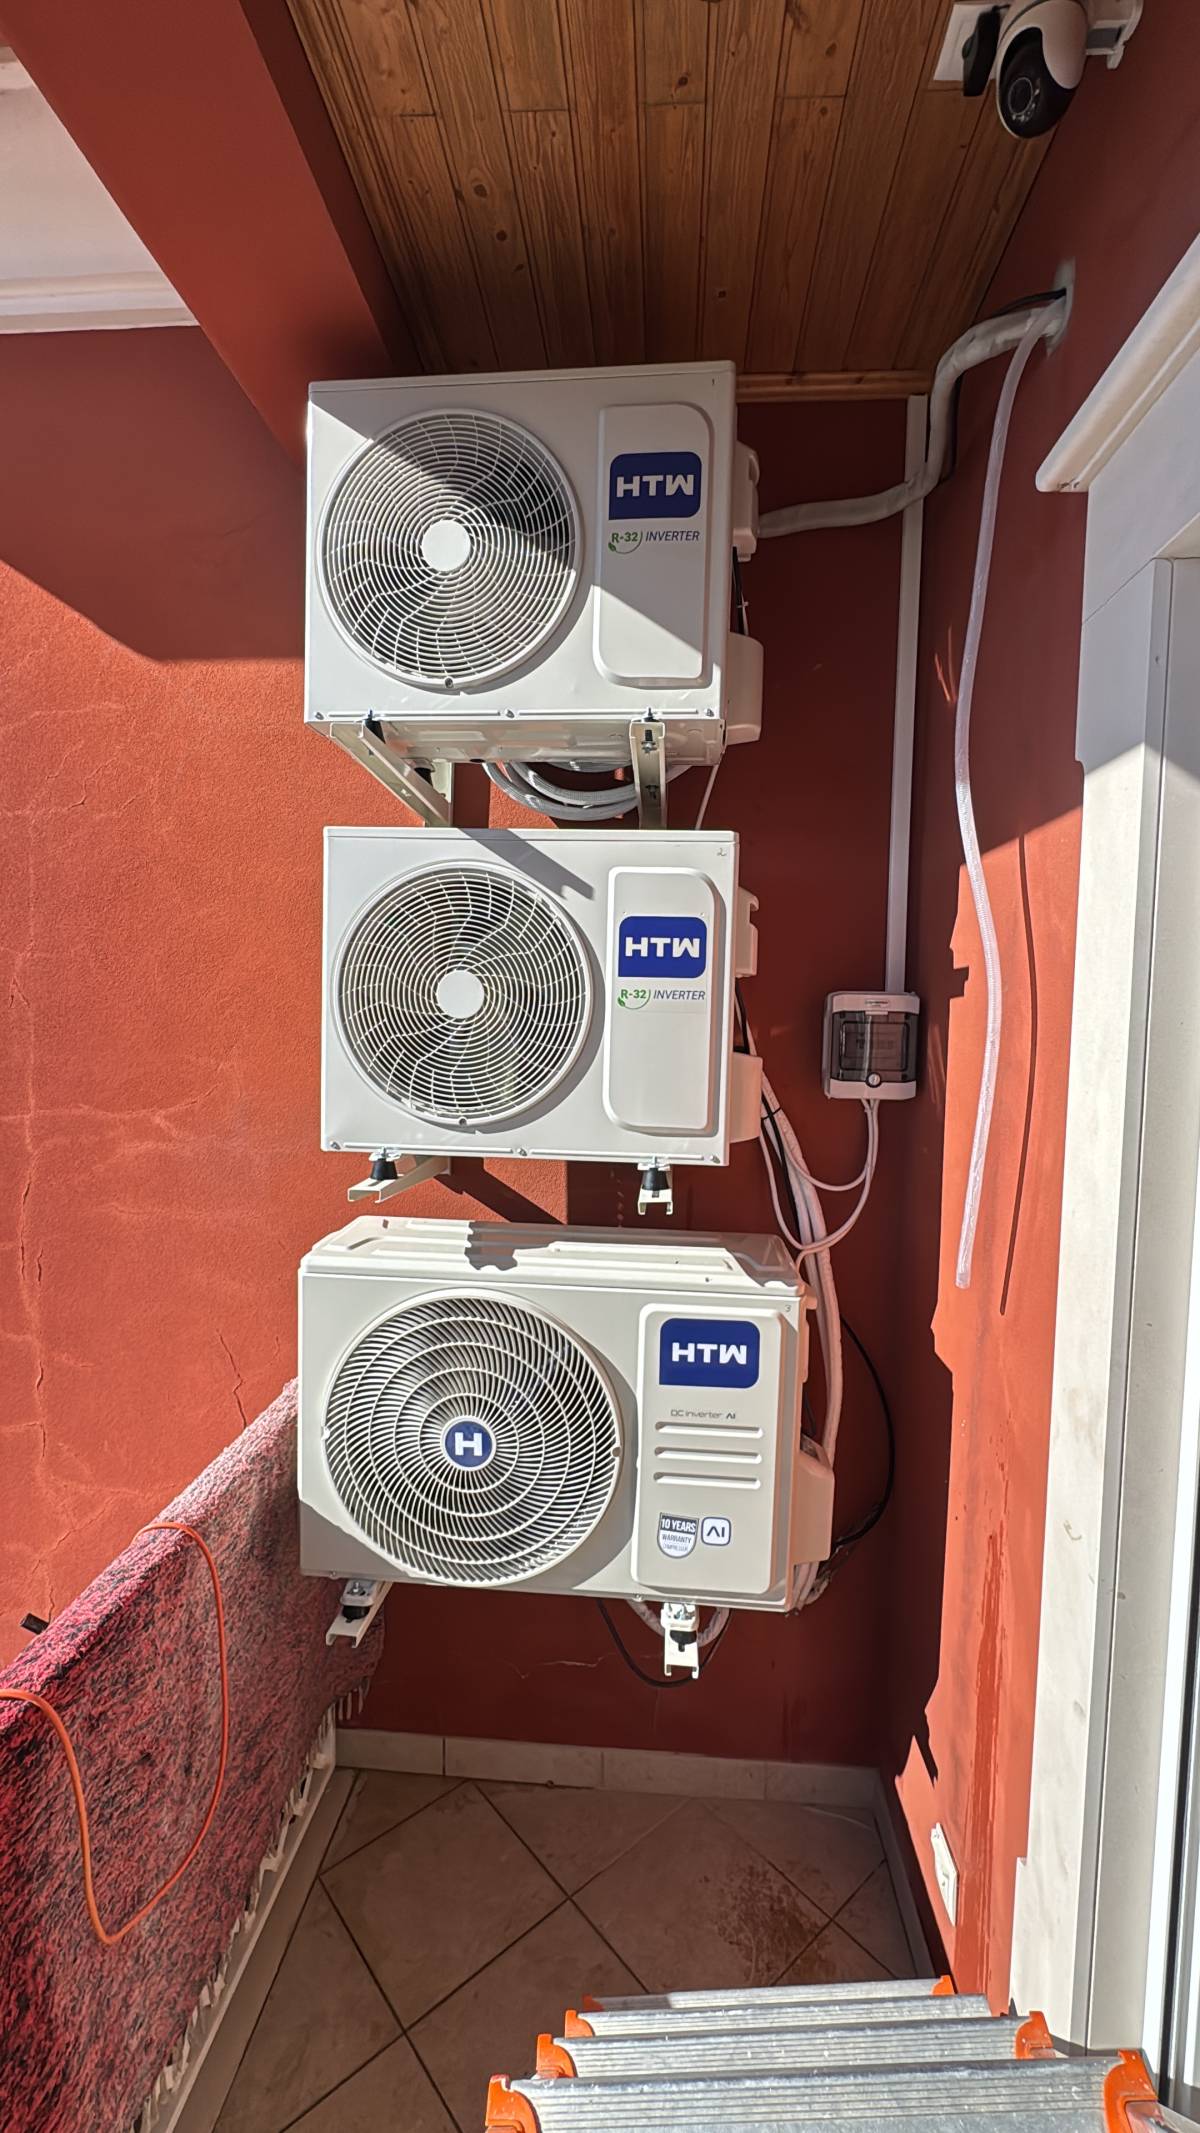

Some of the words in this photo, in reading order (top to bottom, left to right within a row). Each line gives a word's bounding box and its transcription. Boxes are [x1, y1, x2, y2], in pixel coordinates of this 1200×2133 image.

[616, 474, 694, 498] HTW
[612, 532, 637, 543] R-32
[646, 531, 699, 541] INVERTER
[625, 937, 700, 958] HTW
[620, 989, 647, 999] R-32
[653, 990, 705, 1000] INVERTER
[785, 1304, 792, 1313] 3
[671, 1342, 747, 1365] HTW
[670, 1409, 684, 1417] DC
[725, 1412, 736, 1420] AI
[454, 1432, 483, 1457] H
[662, 1518, 670, 1528] 10
[672, 1519, 696, 1532] YEARS
[662, 1533, 691, 1543] WARRANTY
